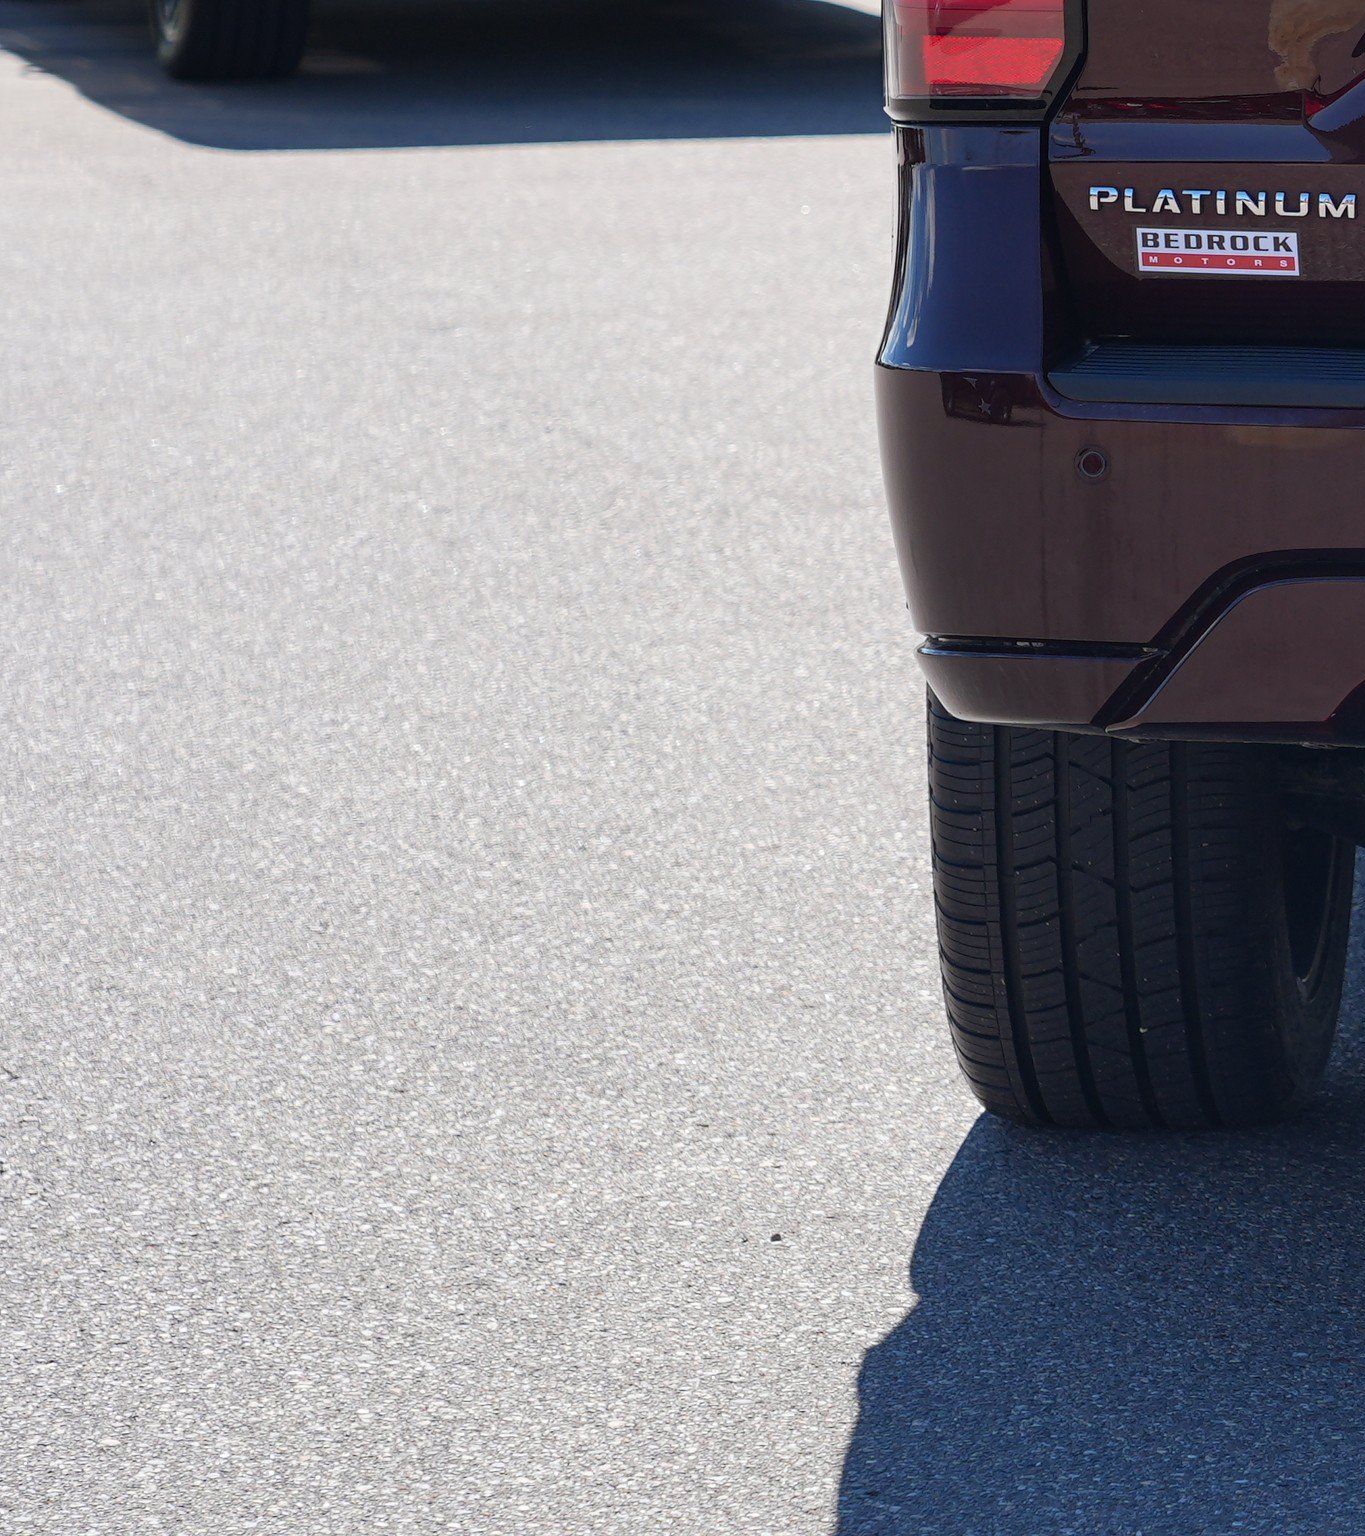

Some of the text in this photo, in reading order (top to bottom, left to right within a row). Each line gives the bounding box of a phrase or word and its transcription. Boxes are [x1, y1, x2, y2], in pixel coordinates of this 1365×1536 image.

[1088, 185, 1356, 219] PLATINUM
[1141, 231, 1294, 253] BEDROCK
[1148, 256, 1288, 268] MOTORS
